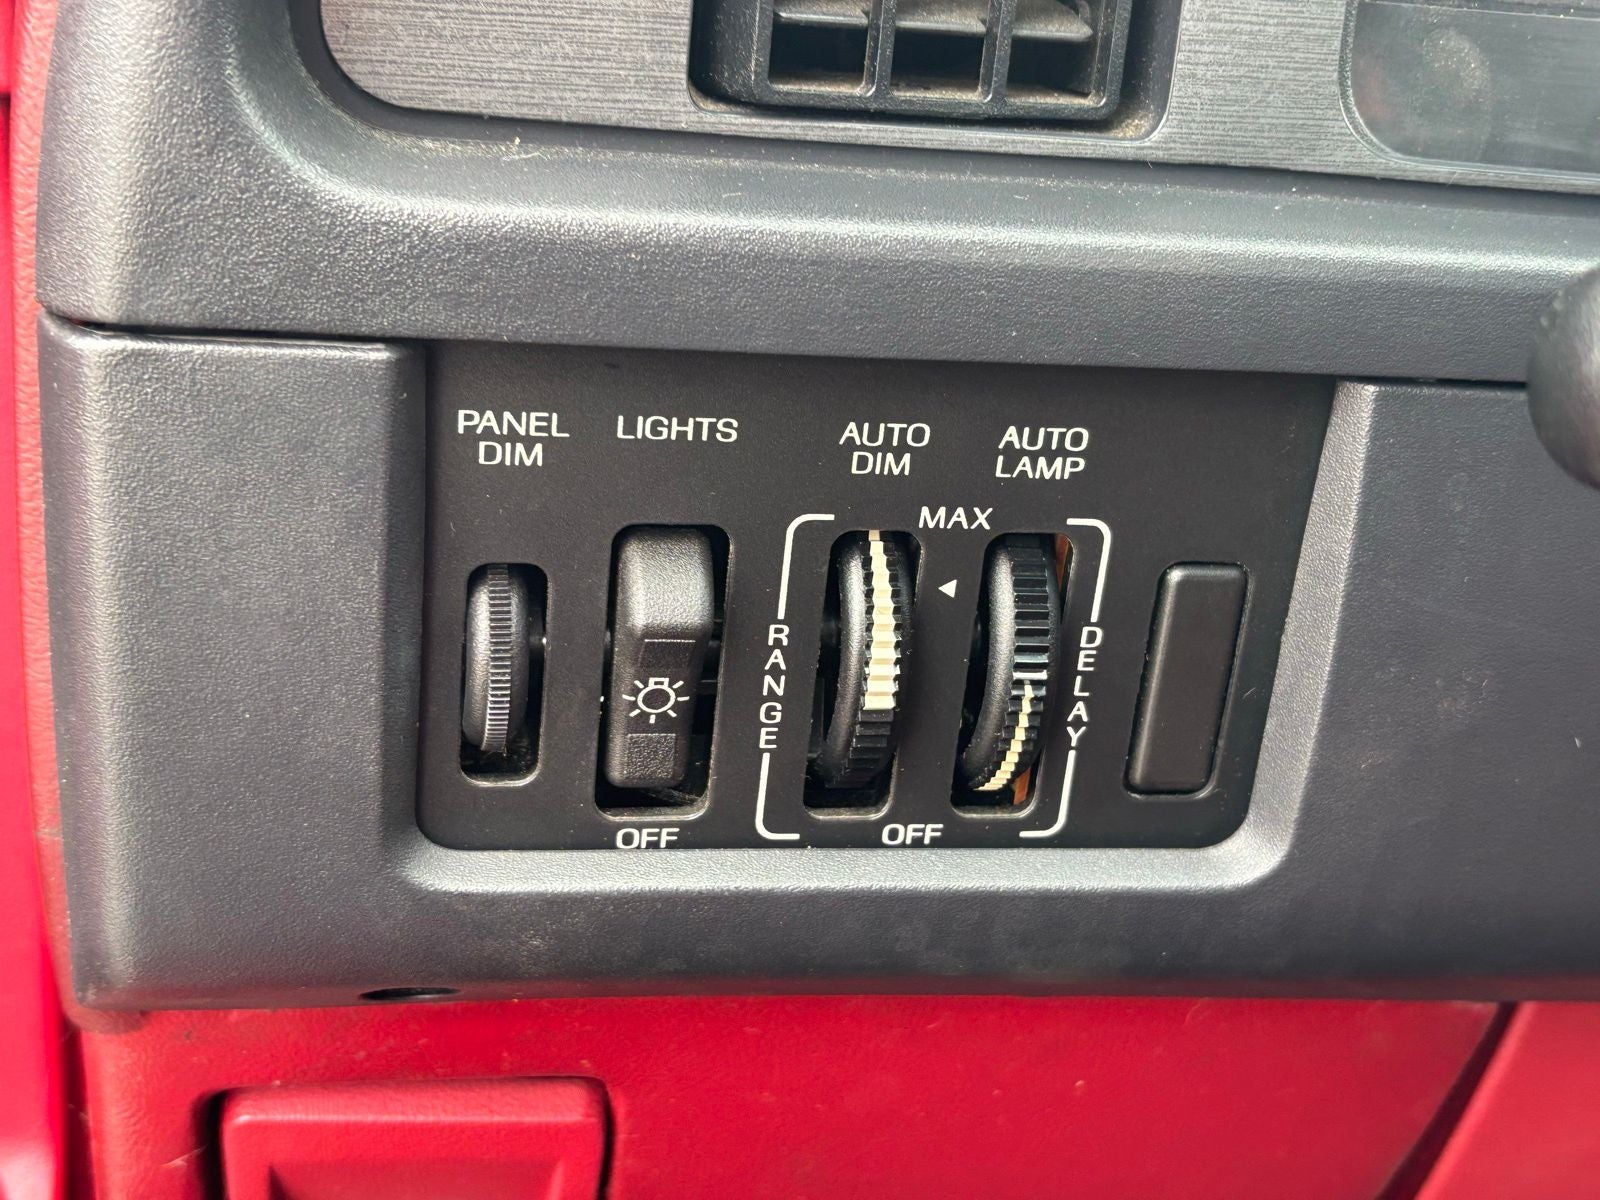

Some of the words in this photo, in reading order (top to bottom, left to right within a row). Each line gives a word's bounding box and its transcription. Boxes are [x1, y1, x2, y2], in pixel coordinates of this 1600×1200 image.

[457, 409, 570, 438] PANEL
[616, 414, 739, 443] LIGHTS
[838, 421, 931, 448] AUTO
[997, 425, 1090, 452] AUTO
[477, 440, 544, 467] DIM
[850, 450, 911, 476] DIM
[995, 454, 1086, 480] LAMP
[918, 505, 994, 531] MAX
[758, 623, 790, 751] RANGE
[1065, 625, 1104, 748] DELAY
[614, 826, 680, 850] OFF
[881, 822, 944, 847] OFF
